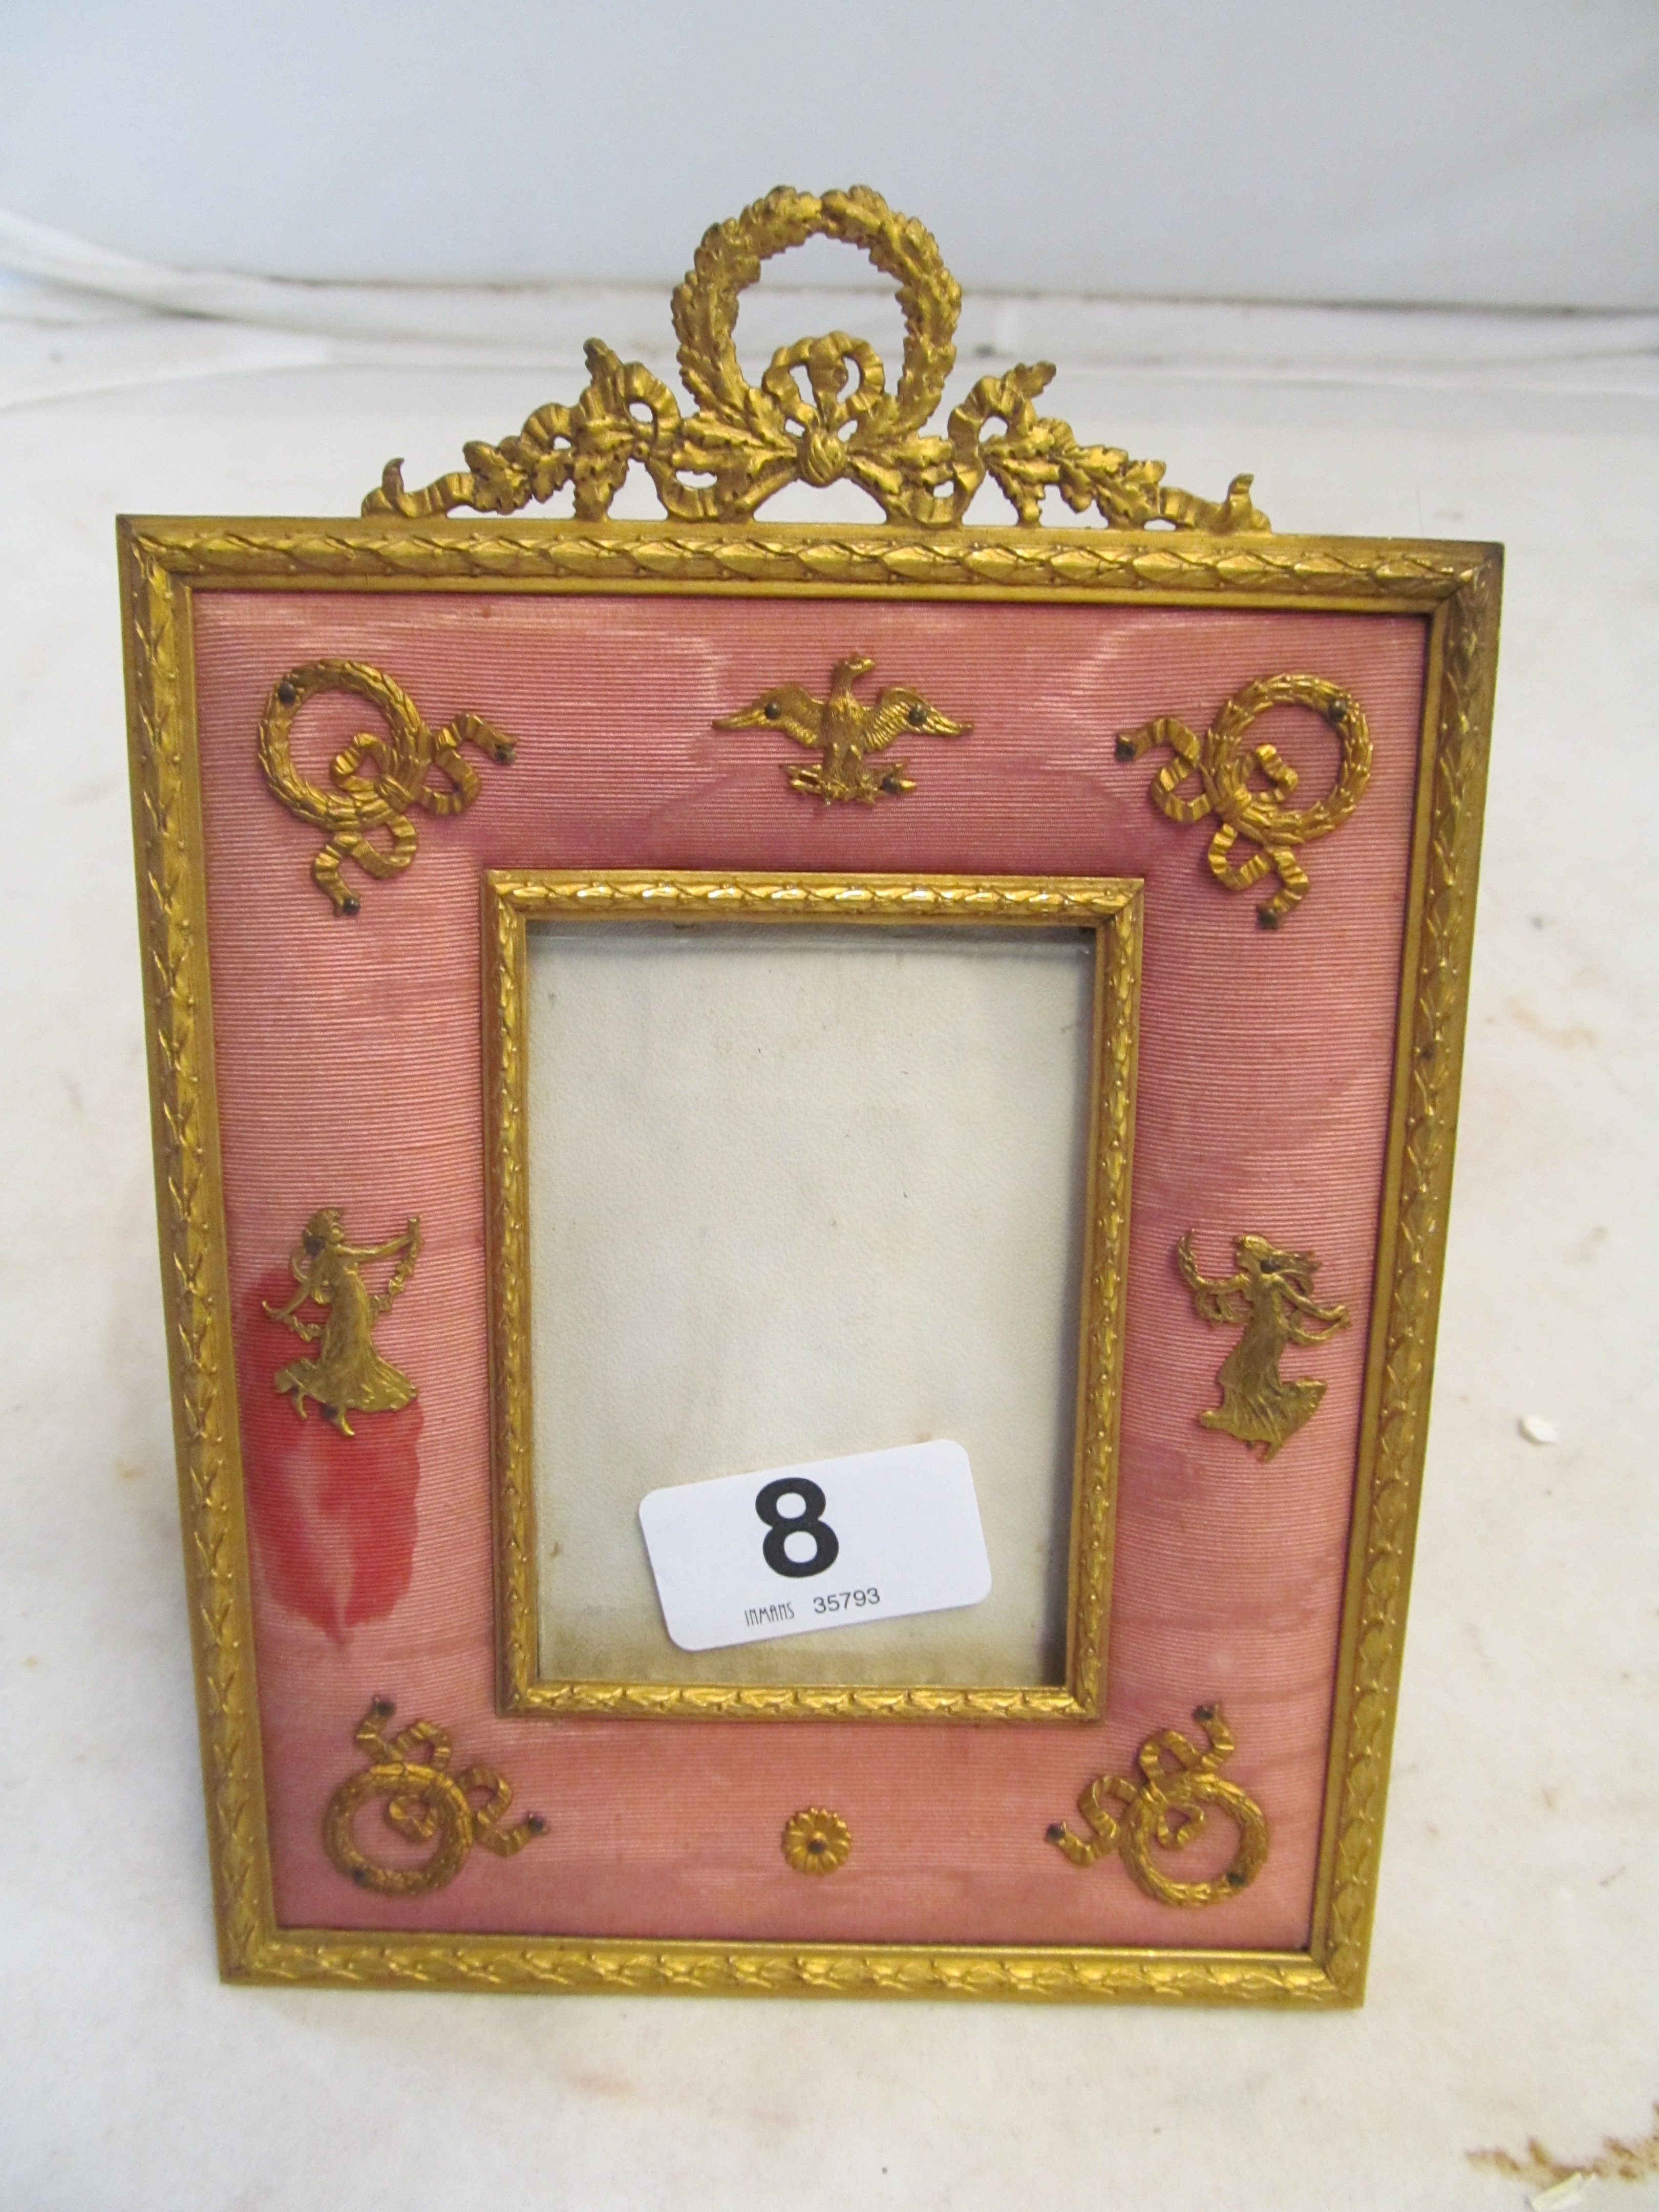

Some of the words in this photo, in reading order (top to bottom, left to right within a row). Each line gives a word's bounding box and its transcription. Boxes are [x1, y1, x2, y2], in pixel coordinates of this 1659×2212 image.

[755, 1477, 839, 1578] 8
[744, 1602, 795, 1627] INMANS
[813, 1587, 881, 1614] 35793
